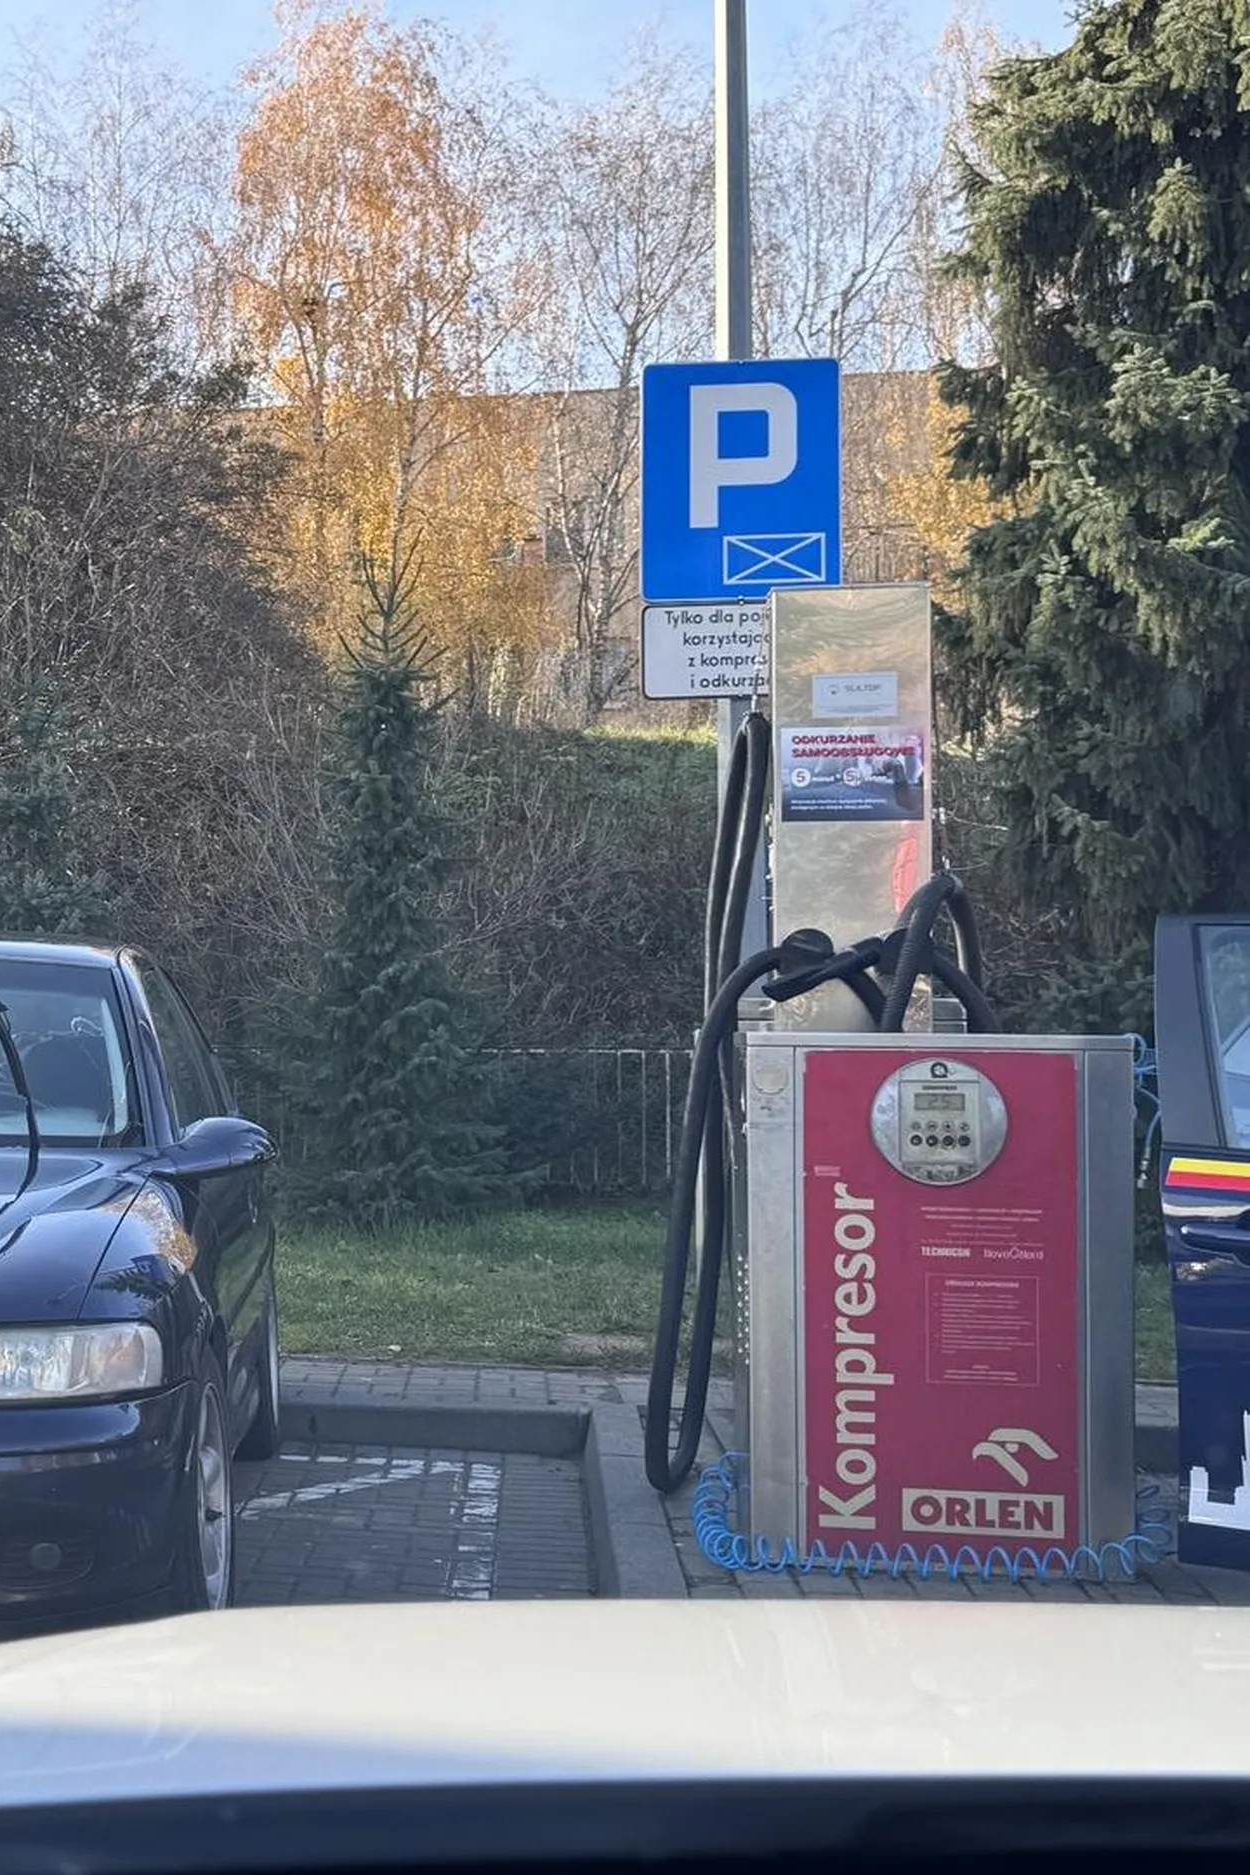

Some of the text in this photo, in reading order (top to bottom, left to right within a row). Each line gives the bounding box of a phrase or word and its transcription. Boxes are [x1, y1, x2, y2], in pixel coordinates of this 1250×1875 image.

[689, 381, 799, 529] P
[664, 610, 704, 629] Tylko
[708, 609, 734, 624] dla
[687, 656, 696, 668] z
[690, 673, 696, 689] i
[791, 734, 876, 746] ODKURZANIE
[796, 770, 806, 783] 5
[818, 1180, 895, 1532] Kompresor
[909, 1494, 1054, 1534] ORLEN
